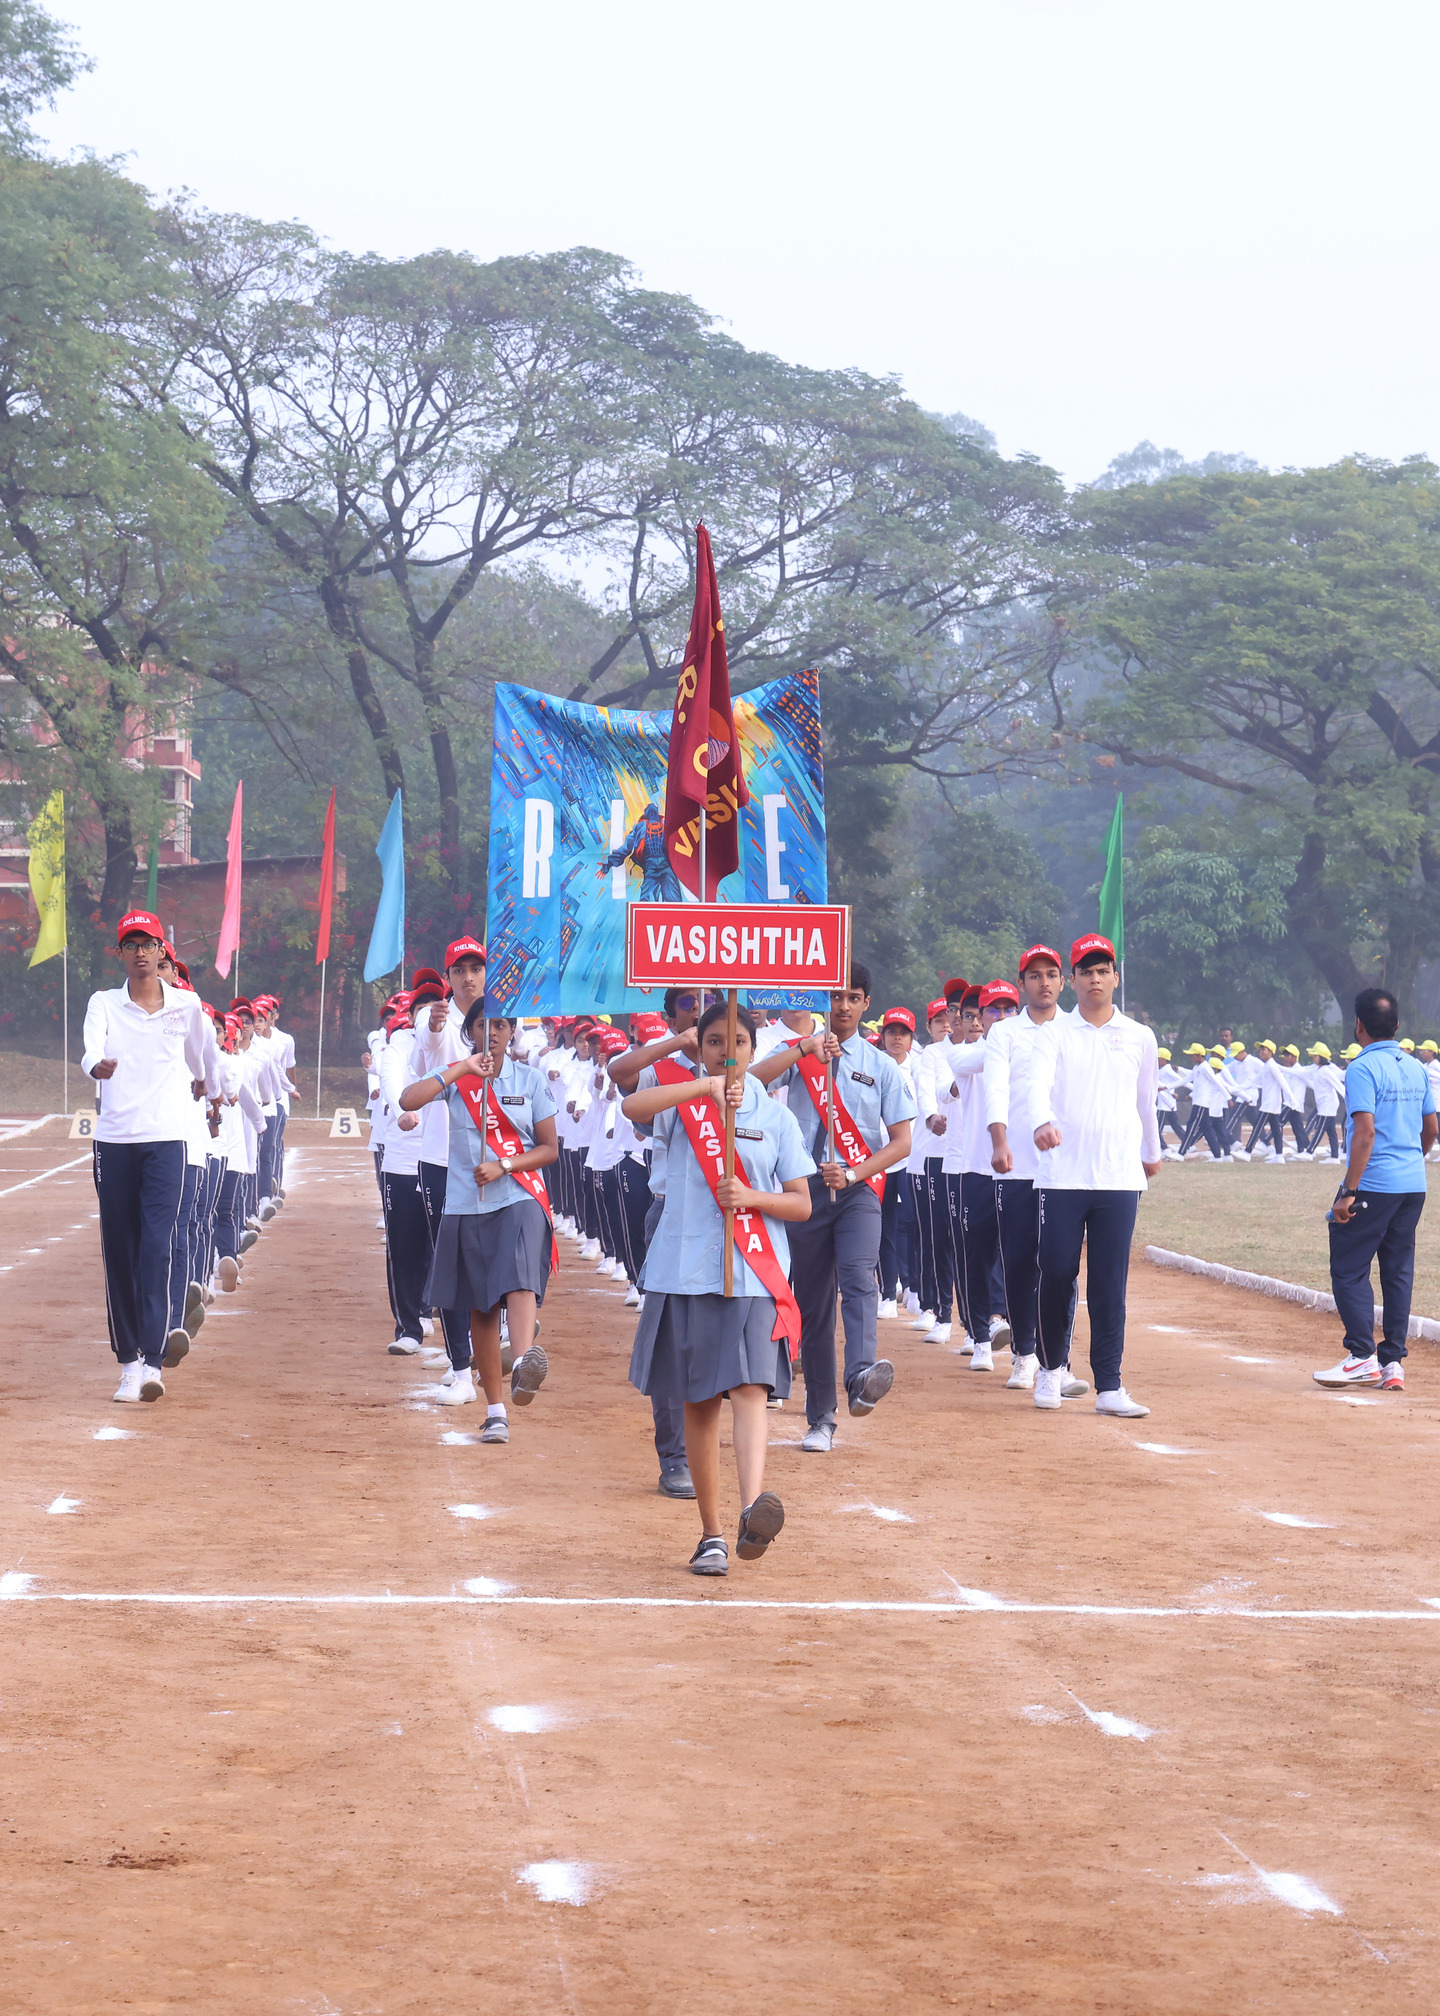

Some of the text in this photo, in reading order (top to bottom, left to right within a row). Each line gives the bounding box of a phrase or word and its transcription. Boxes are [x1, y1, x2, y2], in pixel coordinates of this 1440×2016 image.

[675, 775, 739, 859] VASI
[522, 793, 790, 900] RIE
[122, 916, 151, 930] KHELMELA
[453, 944, 482, 953] KHELMELA
[646, 925, 827, 966] VASISHTHA
[1027, 947, 1054, 957] KHELMELA
[1080, 940, 1109, 951] KHELMELA
[988, 985, 1013, 995] KHELMELA
[162, 1027, 180, 1039] CIRS
[645, 1025, 667, 1034] KHELMELA
[79, 1118, 91, 1136] 8
[339, 1117, 351, 1134] 5
[469, 1088, 545, 1195] VASISA
[689, 1104, 764, 1253] VASITA
[425, 1187, 434, 1216] CIRS
